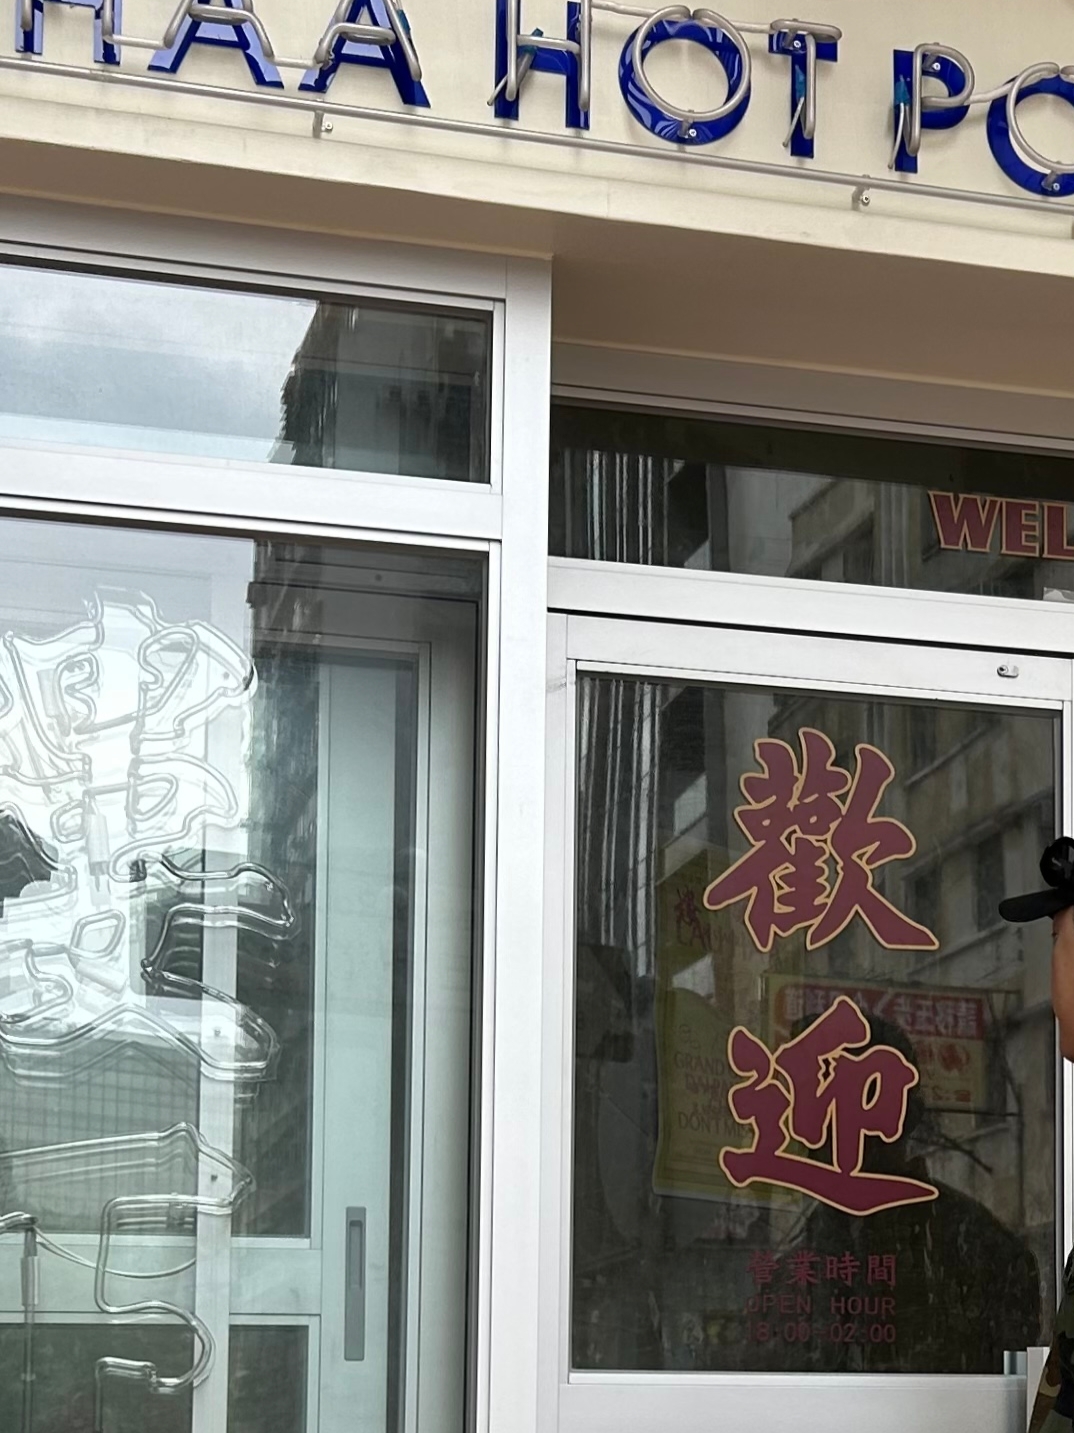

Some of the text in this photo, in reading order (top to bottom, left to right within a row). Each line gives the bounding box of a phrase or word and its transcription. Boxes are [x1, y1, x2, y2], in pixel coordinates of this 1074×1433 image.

[491, 0, 841, 158] HOT
[704, 727, 939, 1216] 歡迎
[745, 1248, 897, 1288] 營業時間
[745, 1294, 897, 1316] OPEN HOUR
